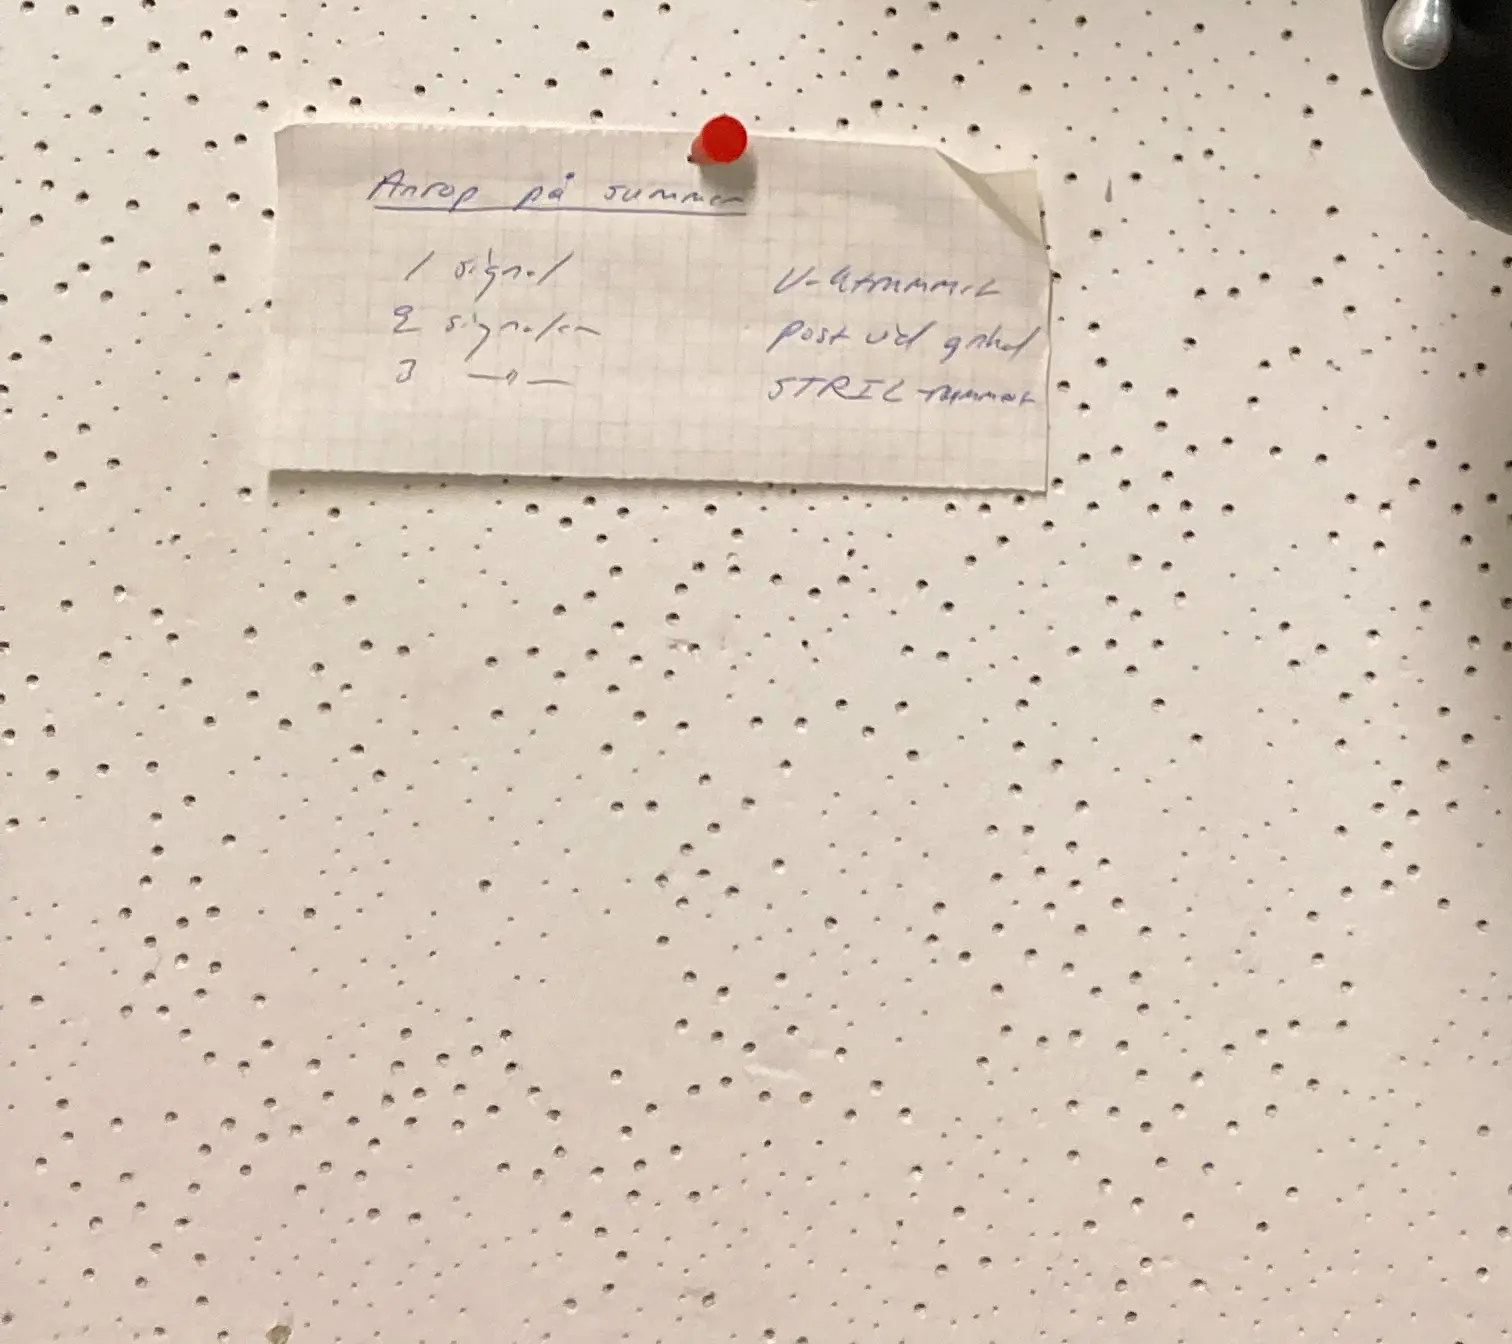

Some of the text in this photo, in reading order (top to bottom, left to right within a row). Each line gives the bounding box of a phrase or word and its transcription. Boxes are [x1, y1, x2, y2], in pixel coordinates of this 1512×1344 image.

[367, 169, 479, 213] Anrop
[511, 170, 576, 212] på
[454, 247, 575, 303] signal
